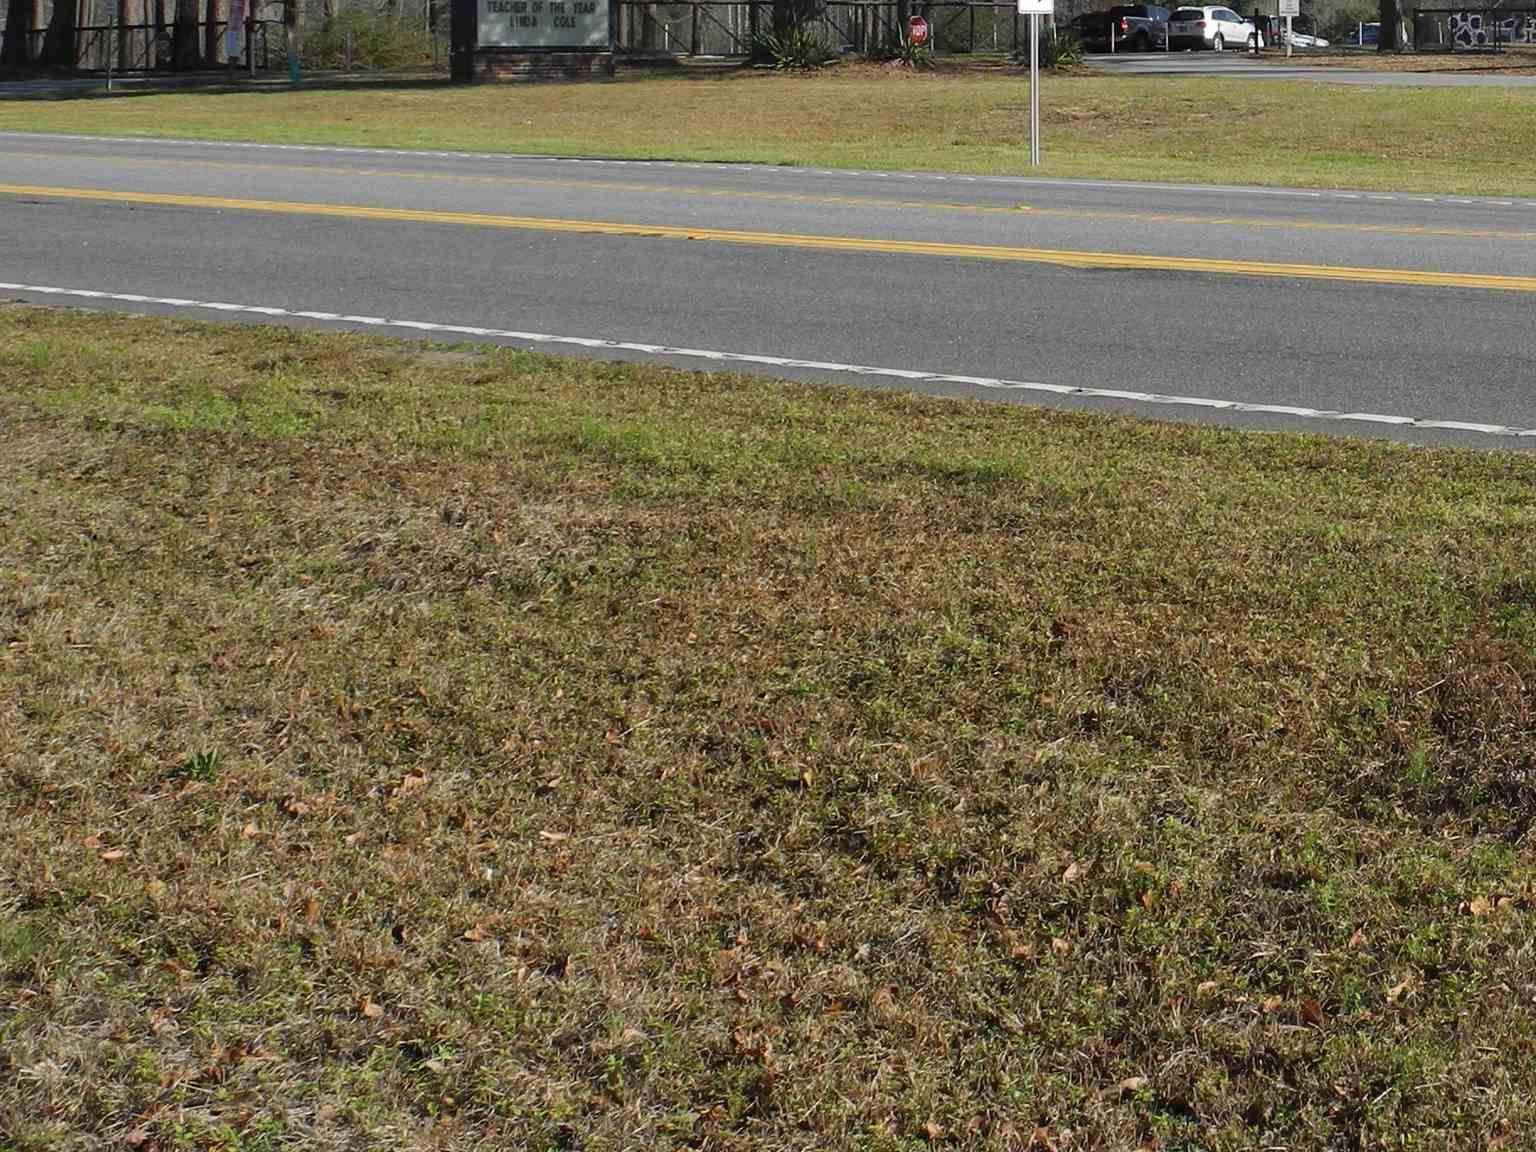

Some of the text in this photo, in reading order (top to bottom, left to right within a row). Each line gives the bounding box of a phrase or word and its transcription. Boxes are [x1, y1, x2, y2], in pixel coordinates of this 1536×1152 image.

[488, 1, 595, 15] TEACHER OF THE YEAR
[509, 16, 576, 28] LINDA COLE
